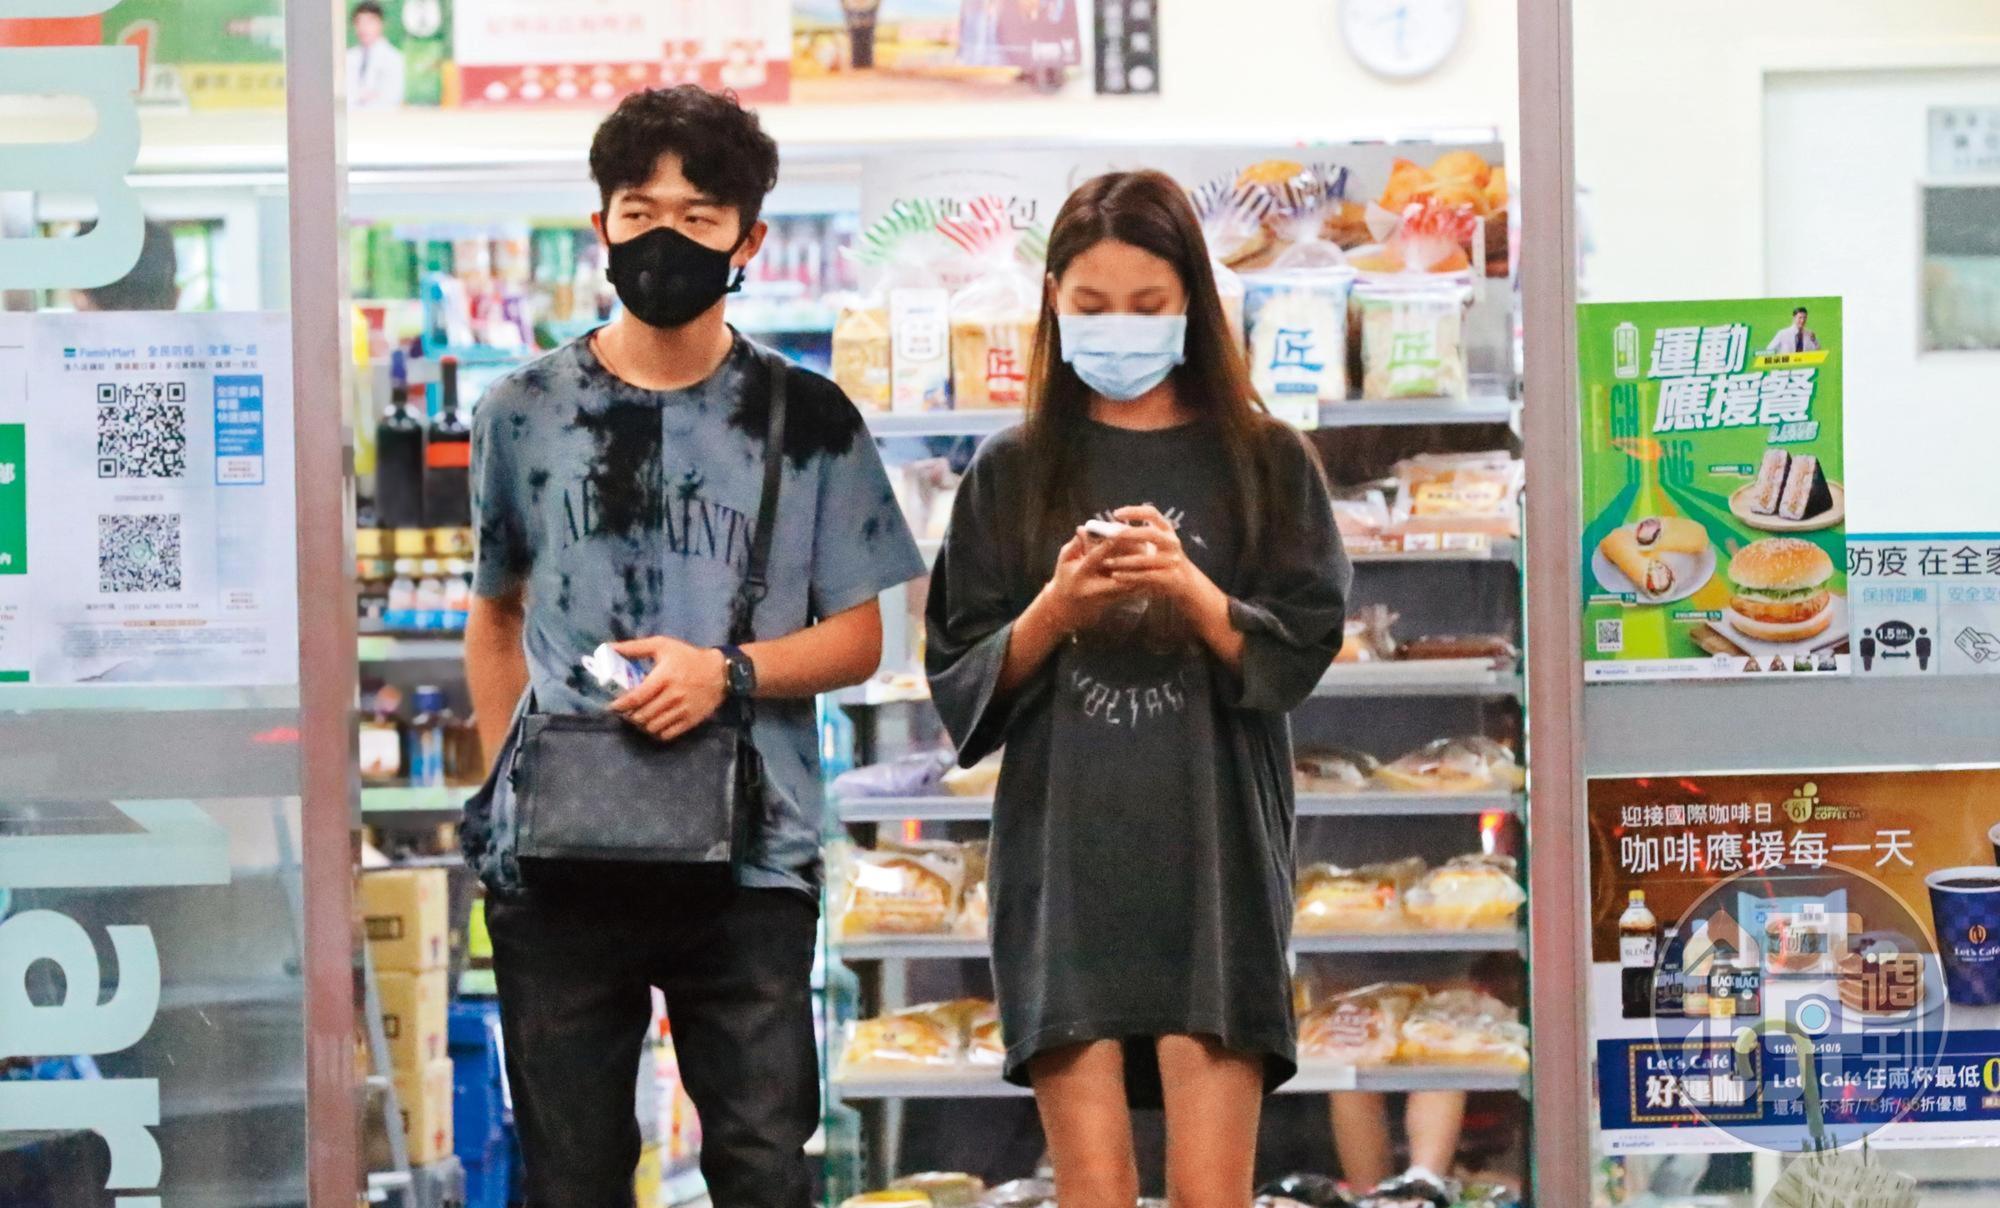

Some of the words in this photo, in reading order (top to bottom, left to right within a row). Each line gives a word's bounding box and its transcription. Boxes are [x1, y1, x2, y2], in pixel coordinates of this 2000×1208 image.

[986, 348, 1026, 381] 匠
[1269, 328, 1325, 372] 匠
[1386, 330, 1441, 371] 匠
[1647, 323, 1750, 379] 運動
[1652, 367, 1817, 434] 應援餐
[1846, 546, 1908, 577] 防疫
[1863, 586, 1927, 603] 保持距離
[1877, 628, 1896, 640] 1.5
[1621, 802, 1772, 828] 迎接國際咖啡日
[1814, 811, 1848, 820] COFFEE
[1620, 828, 1914, 874] 咖啡應援每一天
[1646, 1055, 1687, 1070] Let's
[1689, 1054, 1729, 1070] Café
[1773, 1072, 1804, 1089] Let
[1819, 1071, 1863, 1089] Café
